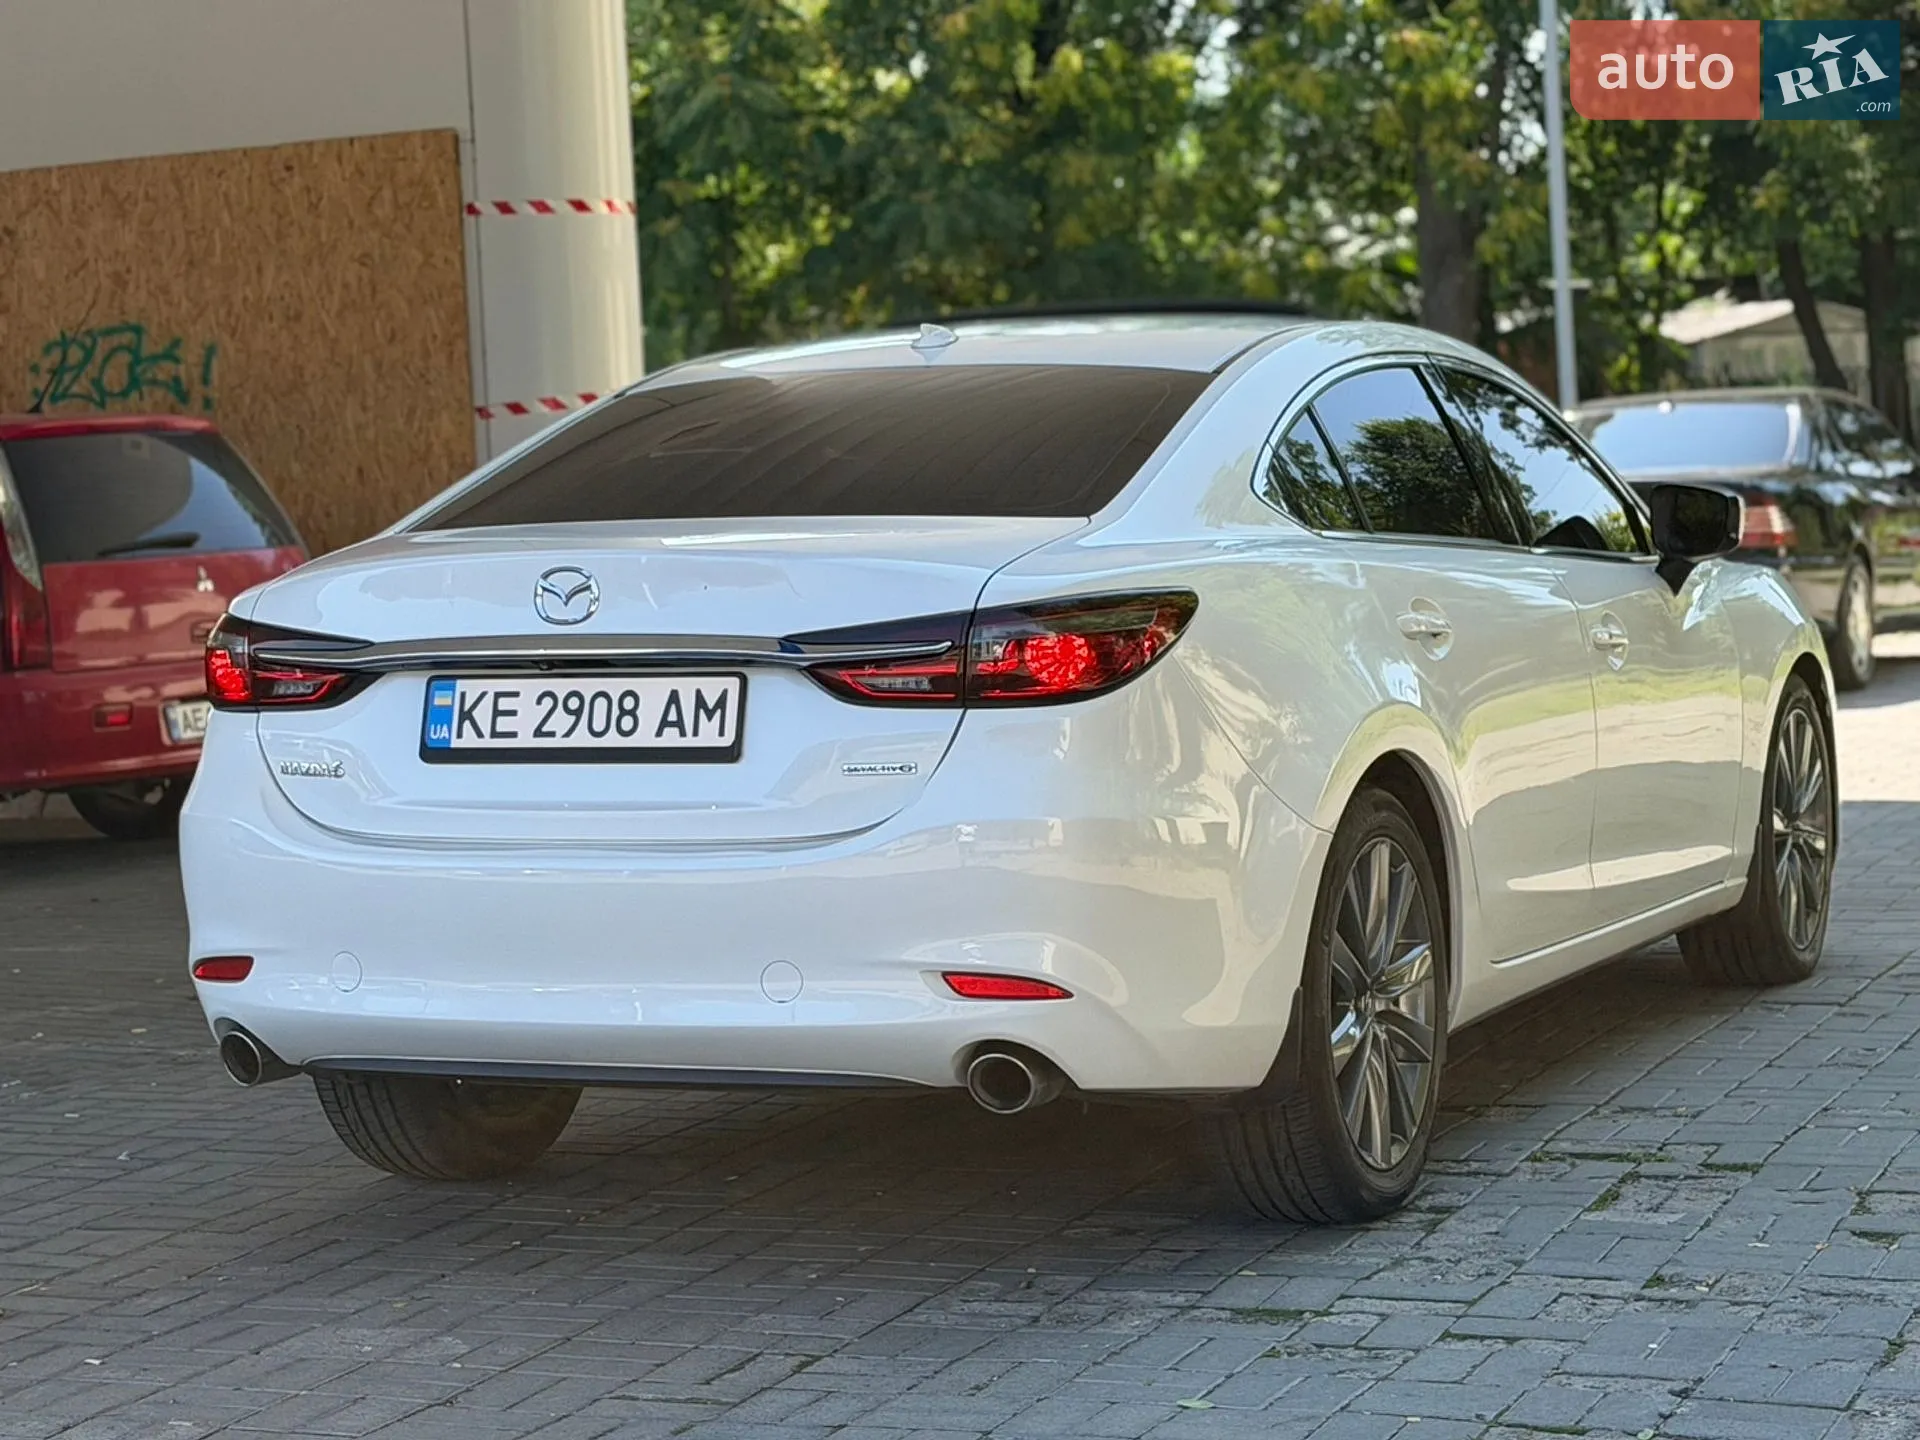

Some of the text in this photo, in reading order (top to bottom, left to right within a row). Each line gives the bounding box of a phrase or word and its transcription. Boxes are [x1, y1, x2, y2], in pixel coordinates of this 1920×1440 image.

[456, 688, 730, 739] KE 2908 AM
[430, 723, 449, 740] UA
